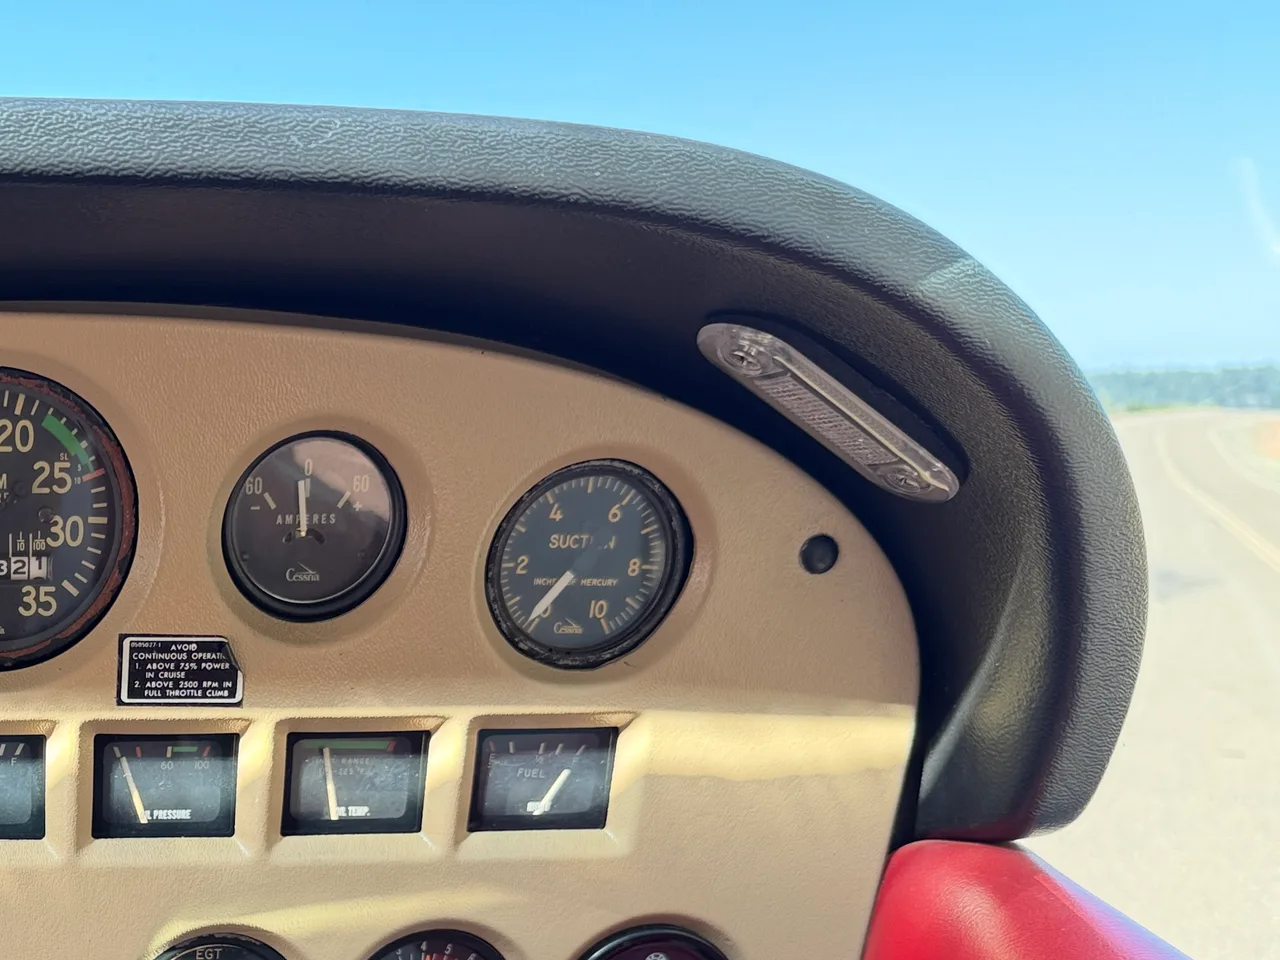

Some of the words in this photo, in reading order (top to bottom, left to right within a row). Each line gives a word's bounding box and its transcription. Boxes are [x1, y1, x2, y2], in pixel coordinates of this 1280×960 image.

[32, 461, 72, 495] 25
[353, 475, 369, 492] 60
[245, 476, 262, 495] 60
[47, 515, 84, 548] 30
[286, 566, 320, 582] Cessna
[580, 578, 618, 587] MERCURY
[18, 586, 57, 617] 35
[589, 600, 608, 619] 10
[170, 643, 197, 651] AVOID
[132, 652, 187, 660] CONTINUOUS
[517, 768, 545, 778] FUEL
[153, 809, 192, 820] PRESSURE
[348, 805, 371, 817] TEMP.
[196, 950, 221, 960] EGT
